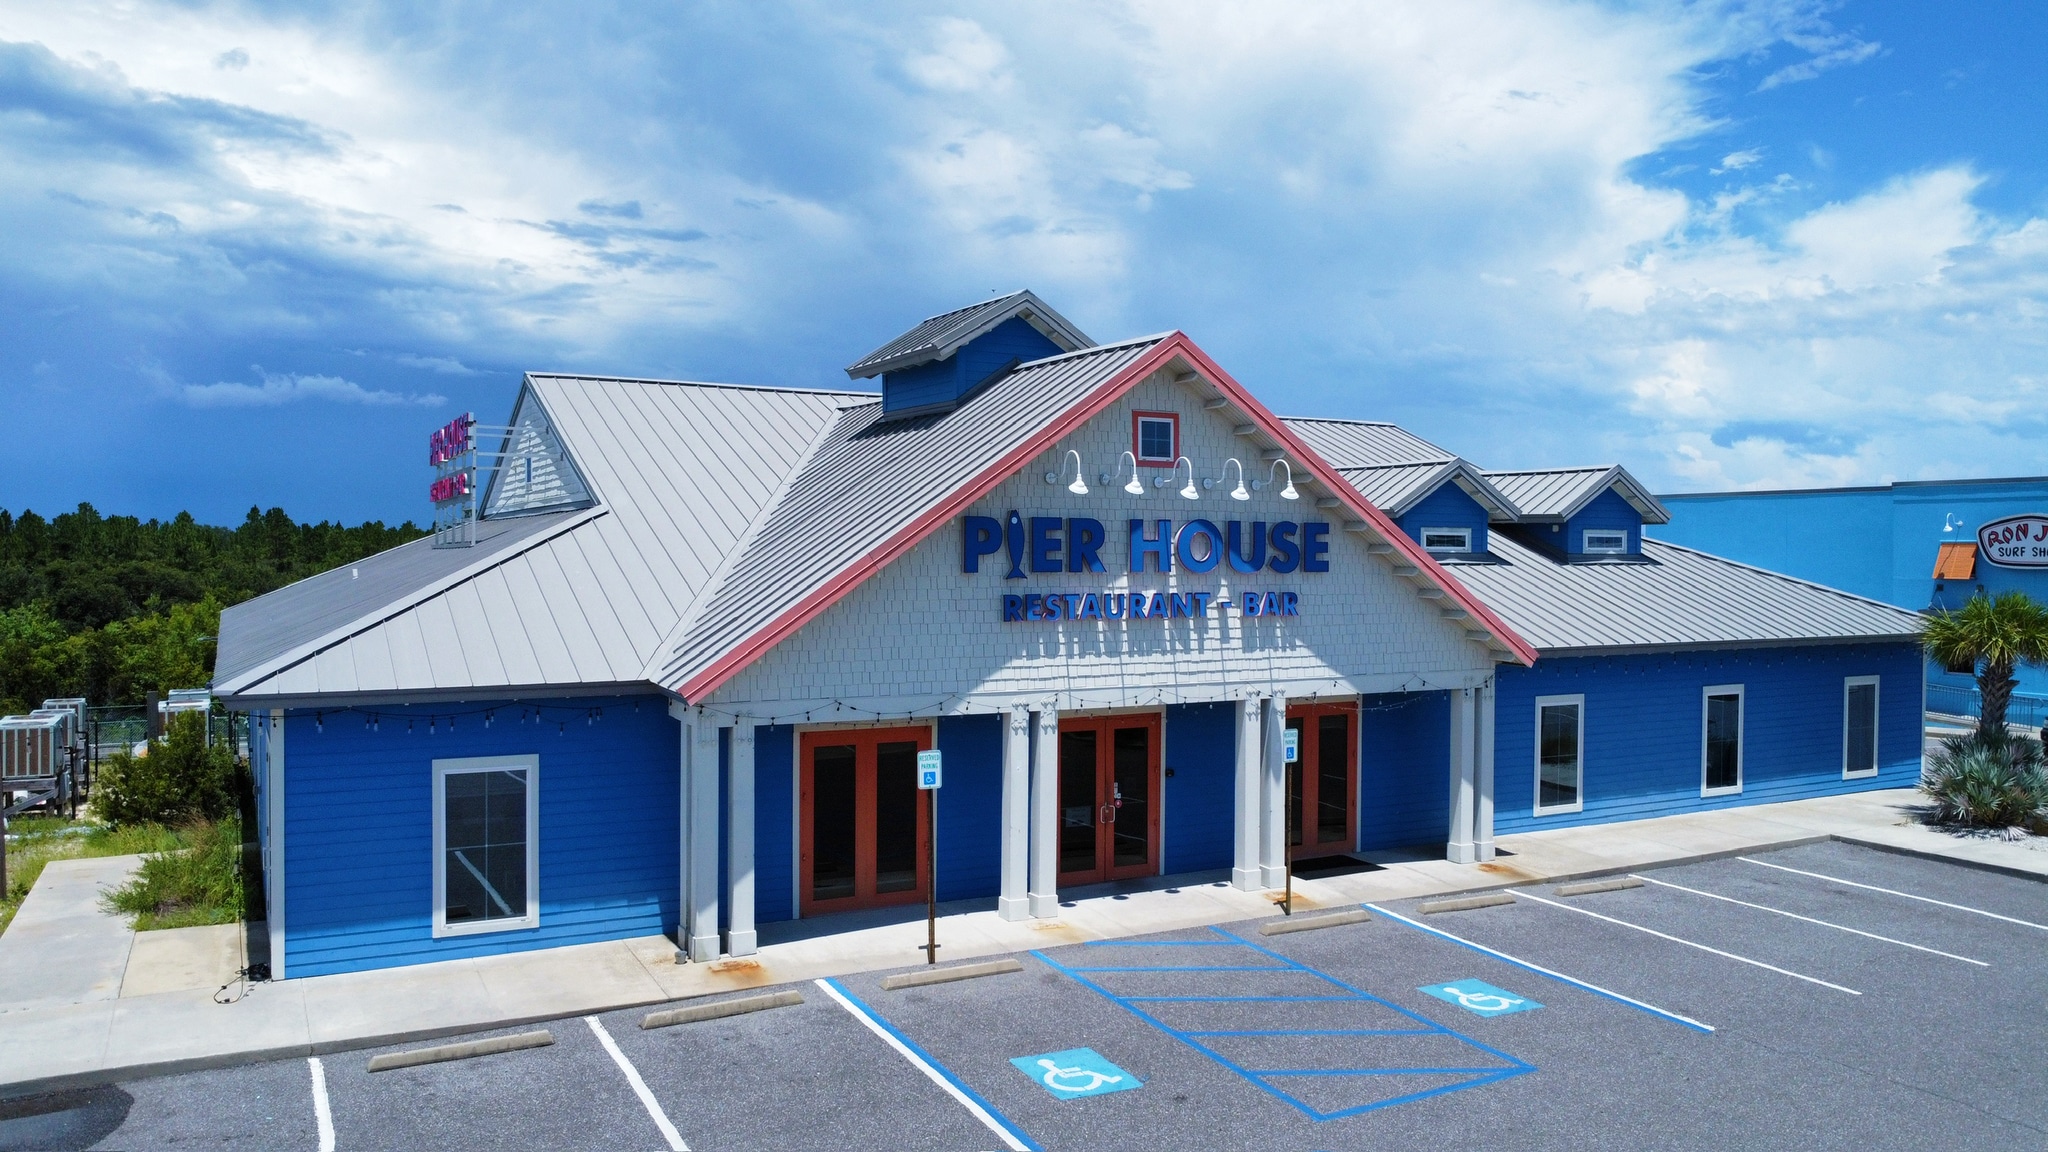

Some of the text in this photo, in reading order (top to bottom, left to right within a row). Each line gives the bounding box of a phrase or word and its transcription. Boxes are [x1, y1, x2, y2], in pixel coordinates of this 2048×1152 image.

[963, 509, 1330, 580] PIER HOUSE
[1988, 523, 2029, 548] RON
[1998, 546, 2048, 557] SURF SH
[1002, 592, 1211, 622] RESTAURANT
[1242, 591, 1299, 618] BAR
